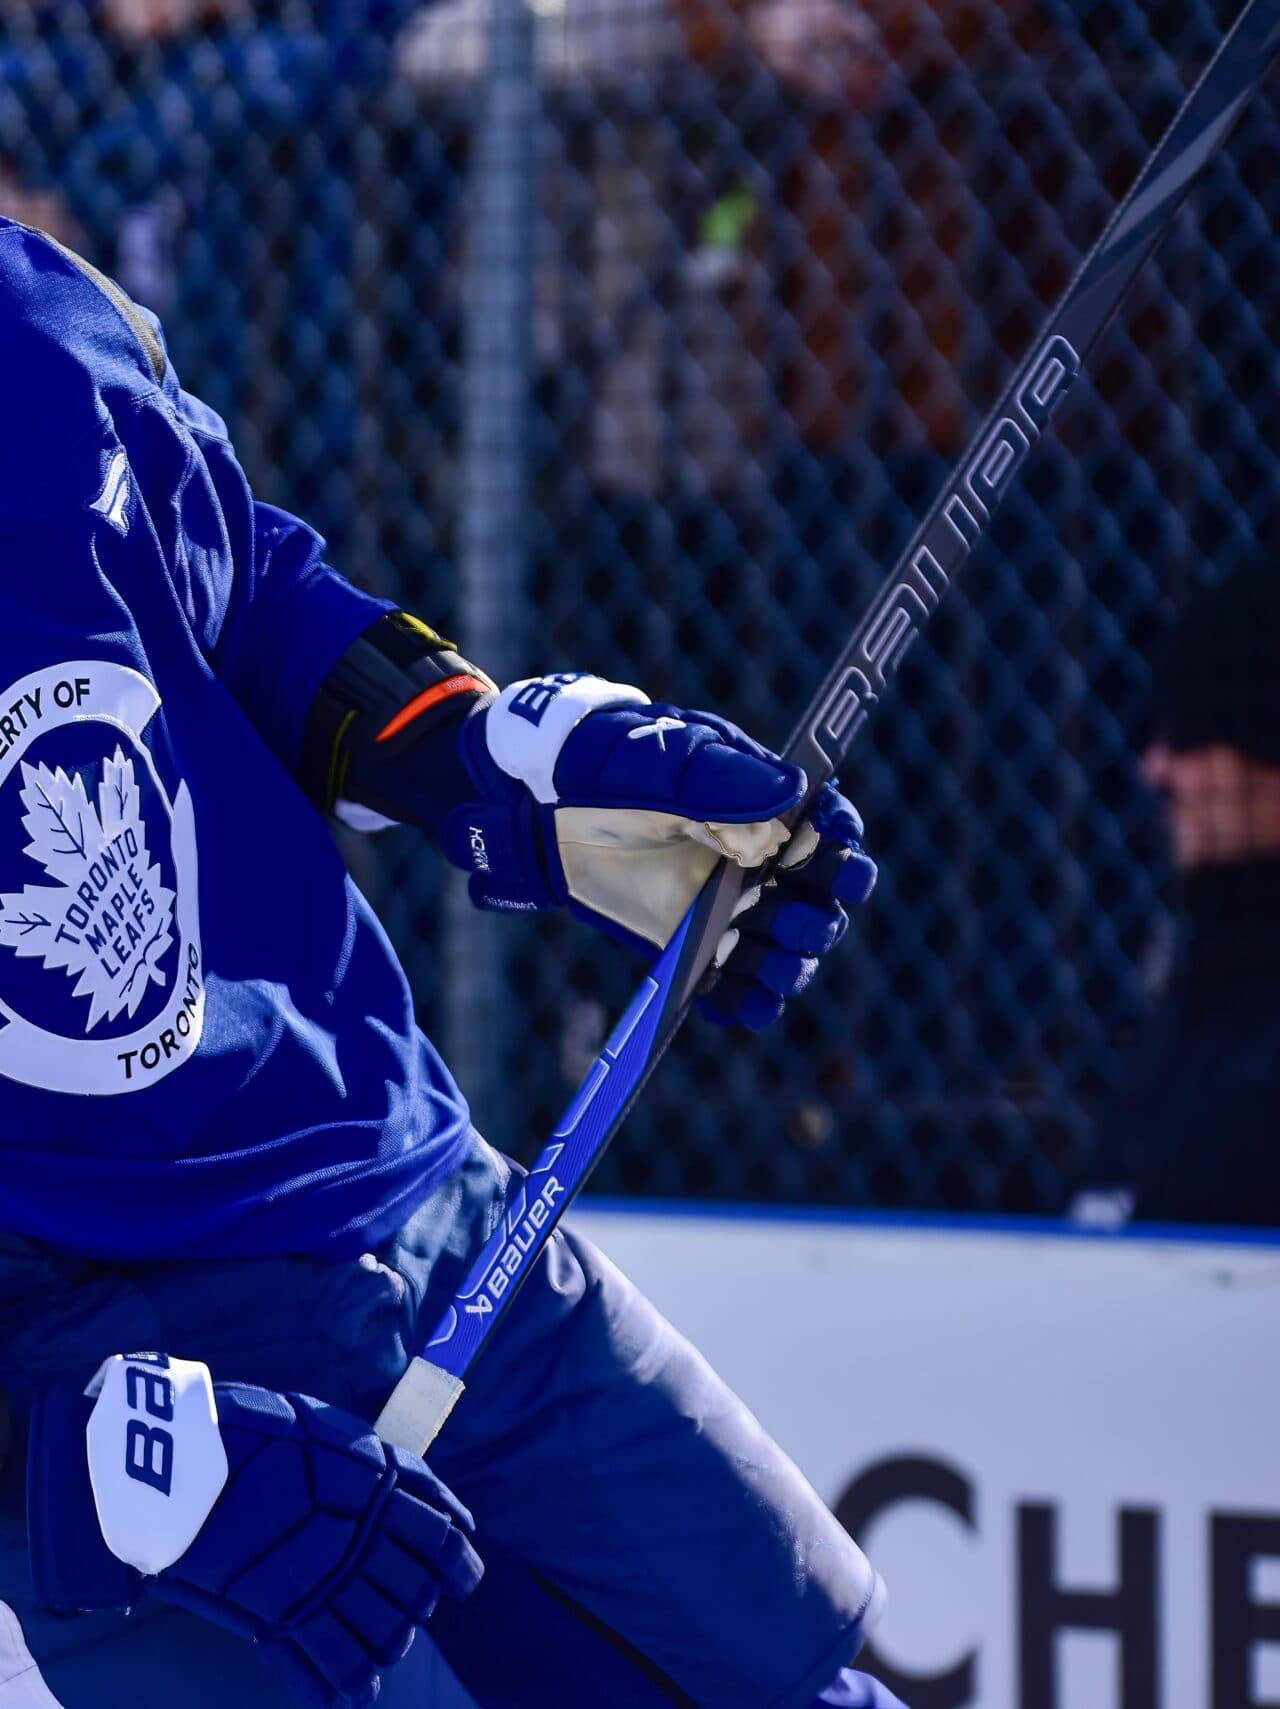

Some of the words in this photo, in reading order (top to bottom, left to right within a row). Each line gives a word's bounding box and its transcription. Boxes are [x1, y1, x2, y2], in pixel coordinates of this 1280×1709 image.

[53, 678, 91, 708] OF
[54, 827, 139, 945] TORONTO
[84, 862, 144, 955] MAPLE
[100, 888, 156, 980] LEAFS
[117, 942, 201, 1079] TORONTO
[487, 1175, 565, 1300] BAUER
